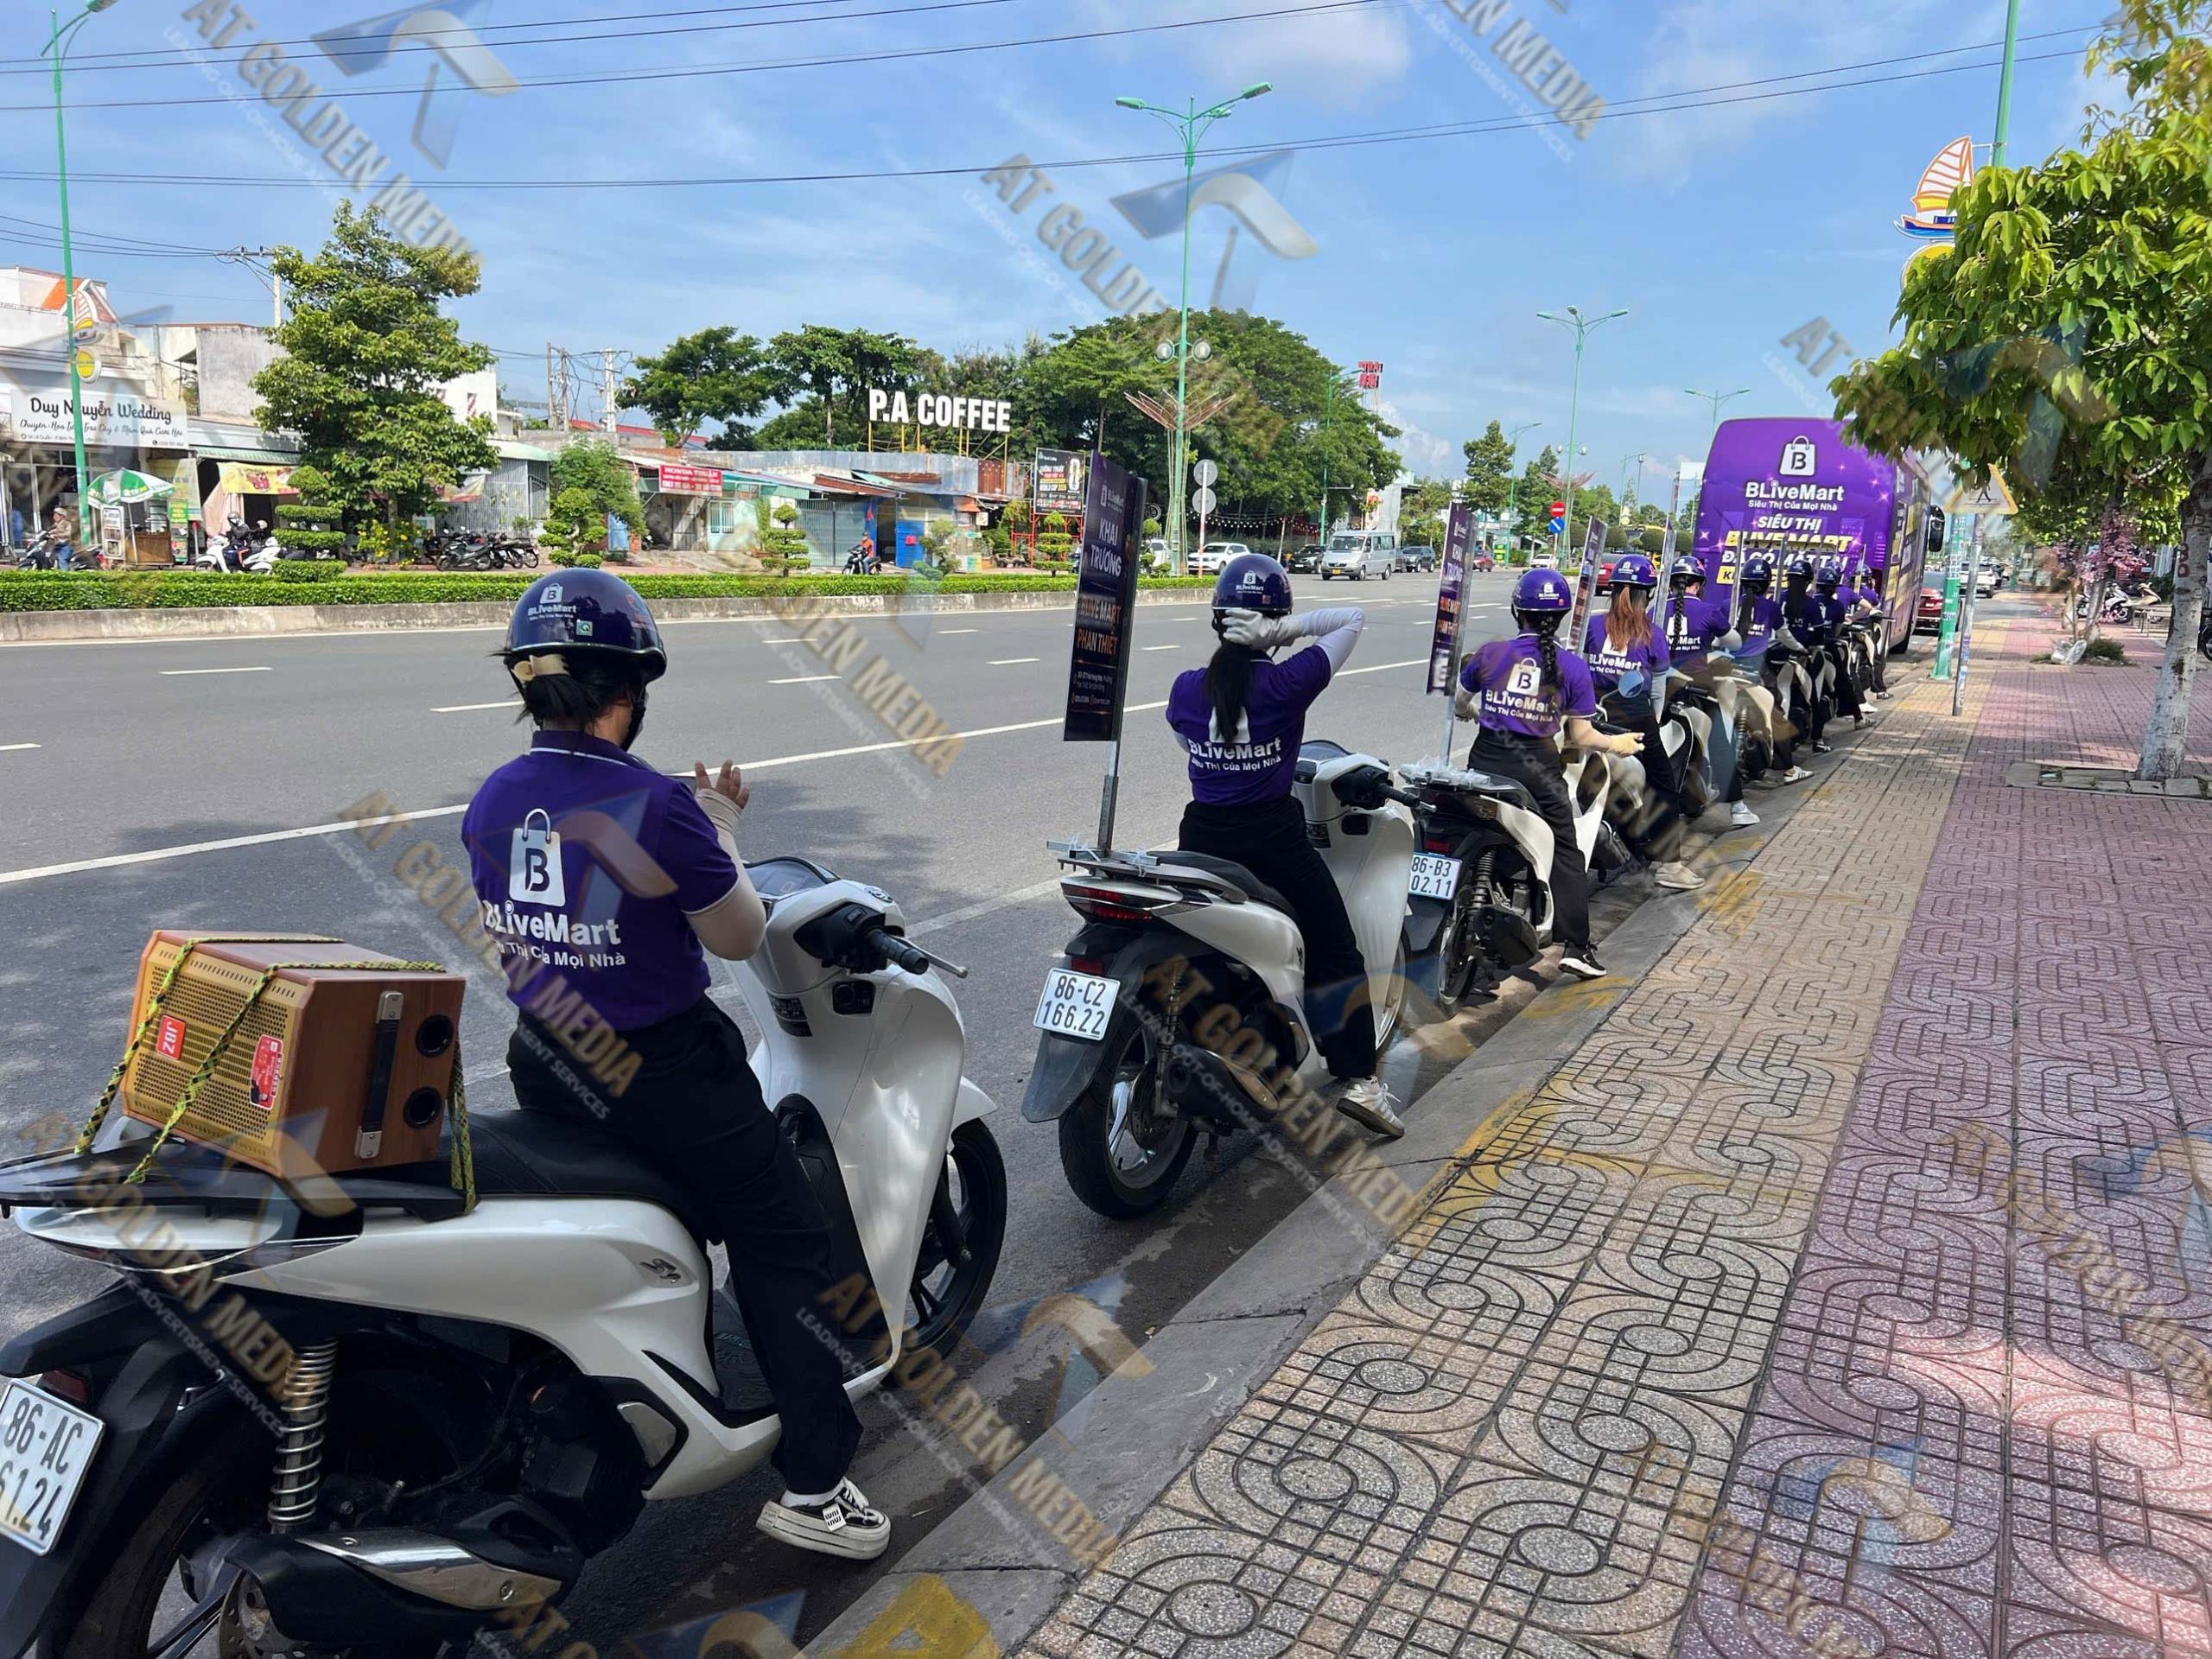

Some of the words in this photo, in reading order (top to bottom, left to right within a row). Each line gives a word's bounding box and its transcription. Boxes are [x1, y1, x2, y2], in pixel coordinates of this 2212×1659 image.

[30, 397, 59, 418] Duy
[64, 399, 112, 420] Nuyễn
[118, 403, 172, 424] Wedding
[868, 389, 909, 423] P.A
[918, 393, 1011, 432] COFFEE
[1745, 480, 1845, 501] BLiveMart
[1748, 499, 1767, 508] Siêu
[1769, 500, 1783, 510] Thị
[1783, 500, 1801, 510] Của
[1802, 503, 1818, 512] Mọi
[1099, 518, 1118, 545] KHAI
[1758, 513, 1795, 530] SIÊU
[1796, 518, 1822, 534] THỊ
[527, 604, 577, 616] BLiveMart
[1100, 601, 1122, 625] MART
[1077, 628, 1097, 653] PHAN
[1188, 736, 1281, 760] BLiveMart
[1223, 759, 1241, 772] Của
[1242, 760, 1262, 772] Mọi
[1262, 754, 1281, 768] Nhà
[525, 848, 550, 892] B
[1412, 857, 1452, 877] 86-B3
[1411, 874, 1452, 897] 02.11
[482, 899, 622, 946] BLiveMart
[554, 951, 585, 969] Mọi
[589, 952, 626, 968] Nhà
[1053, 975, 1107, 1007] 86-C2
[1043, 1000, 1105, 1035] 166.22
[3, 1396, 84, 1475] 86-AC
